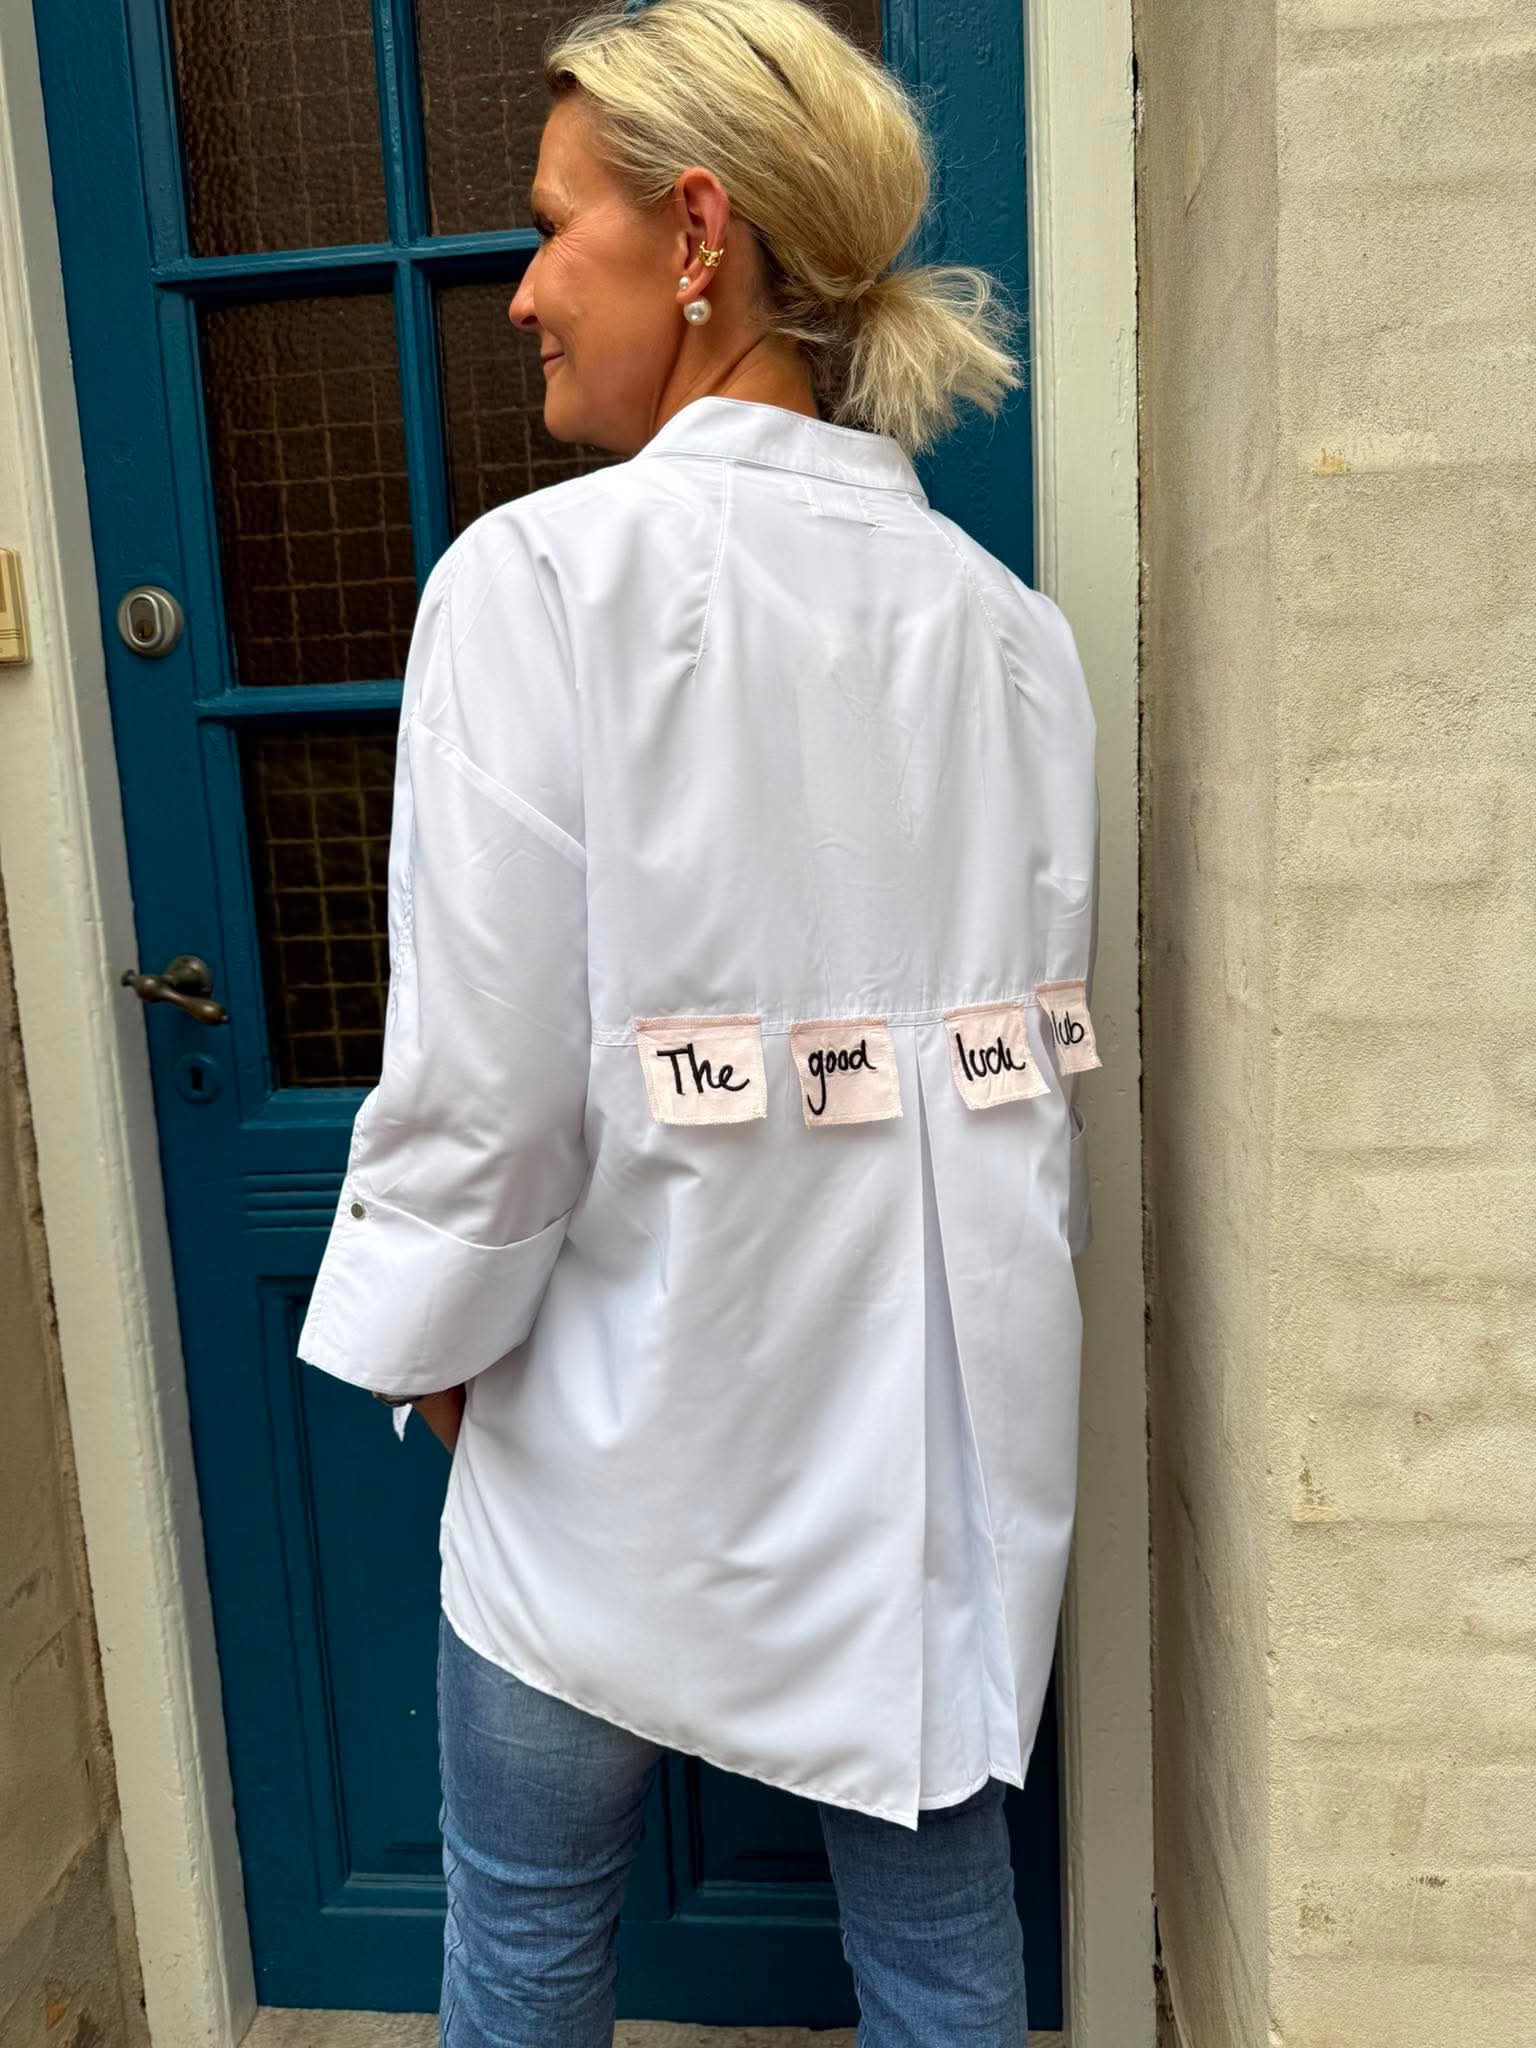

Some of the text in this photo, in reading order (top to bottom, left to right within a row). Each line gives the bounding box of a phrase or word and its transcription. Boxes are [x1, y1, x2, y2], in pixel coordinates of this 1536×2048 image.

[656, 1042, 750, 1096] The
[806, 1039, 877, 1116] good
[1050, 1009, 1085, 1049] lub
